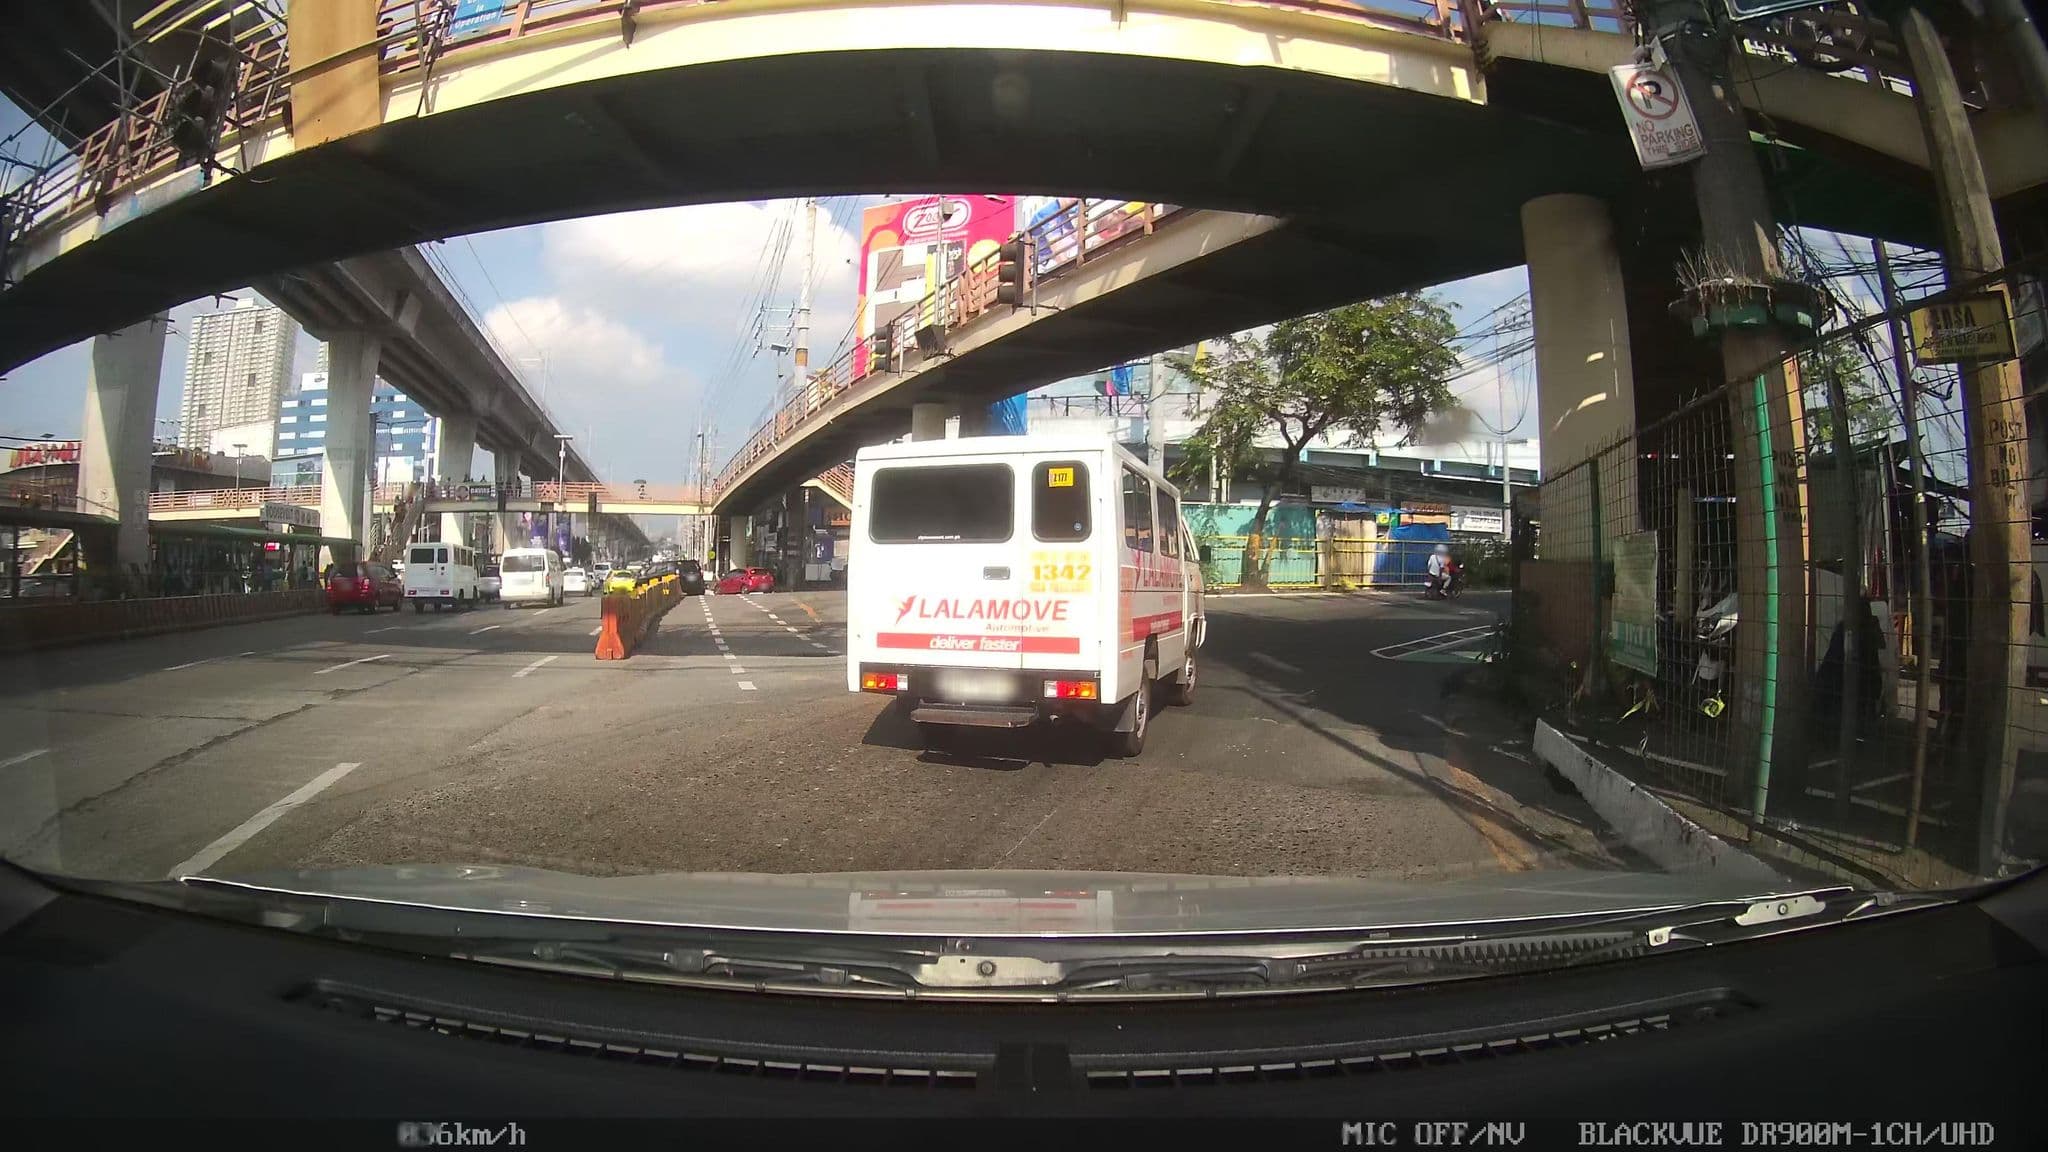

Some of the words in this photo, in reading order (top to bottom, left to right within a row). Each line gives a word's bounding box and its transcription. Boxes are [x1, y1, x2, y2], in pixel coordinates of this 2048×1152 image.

[1636, 119, 1655, 134] NO
[1640, 123, 1694, 146] PARKING
[1989, 419, 2024, 441] POST
[1032, 564, 1091, 581] 1342
[918, 598, 1071, 621] LALAMOVE
[929, 635, 977, 650] deliver
[979, 636, 1021, 651] faster
